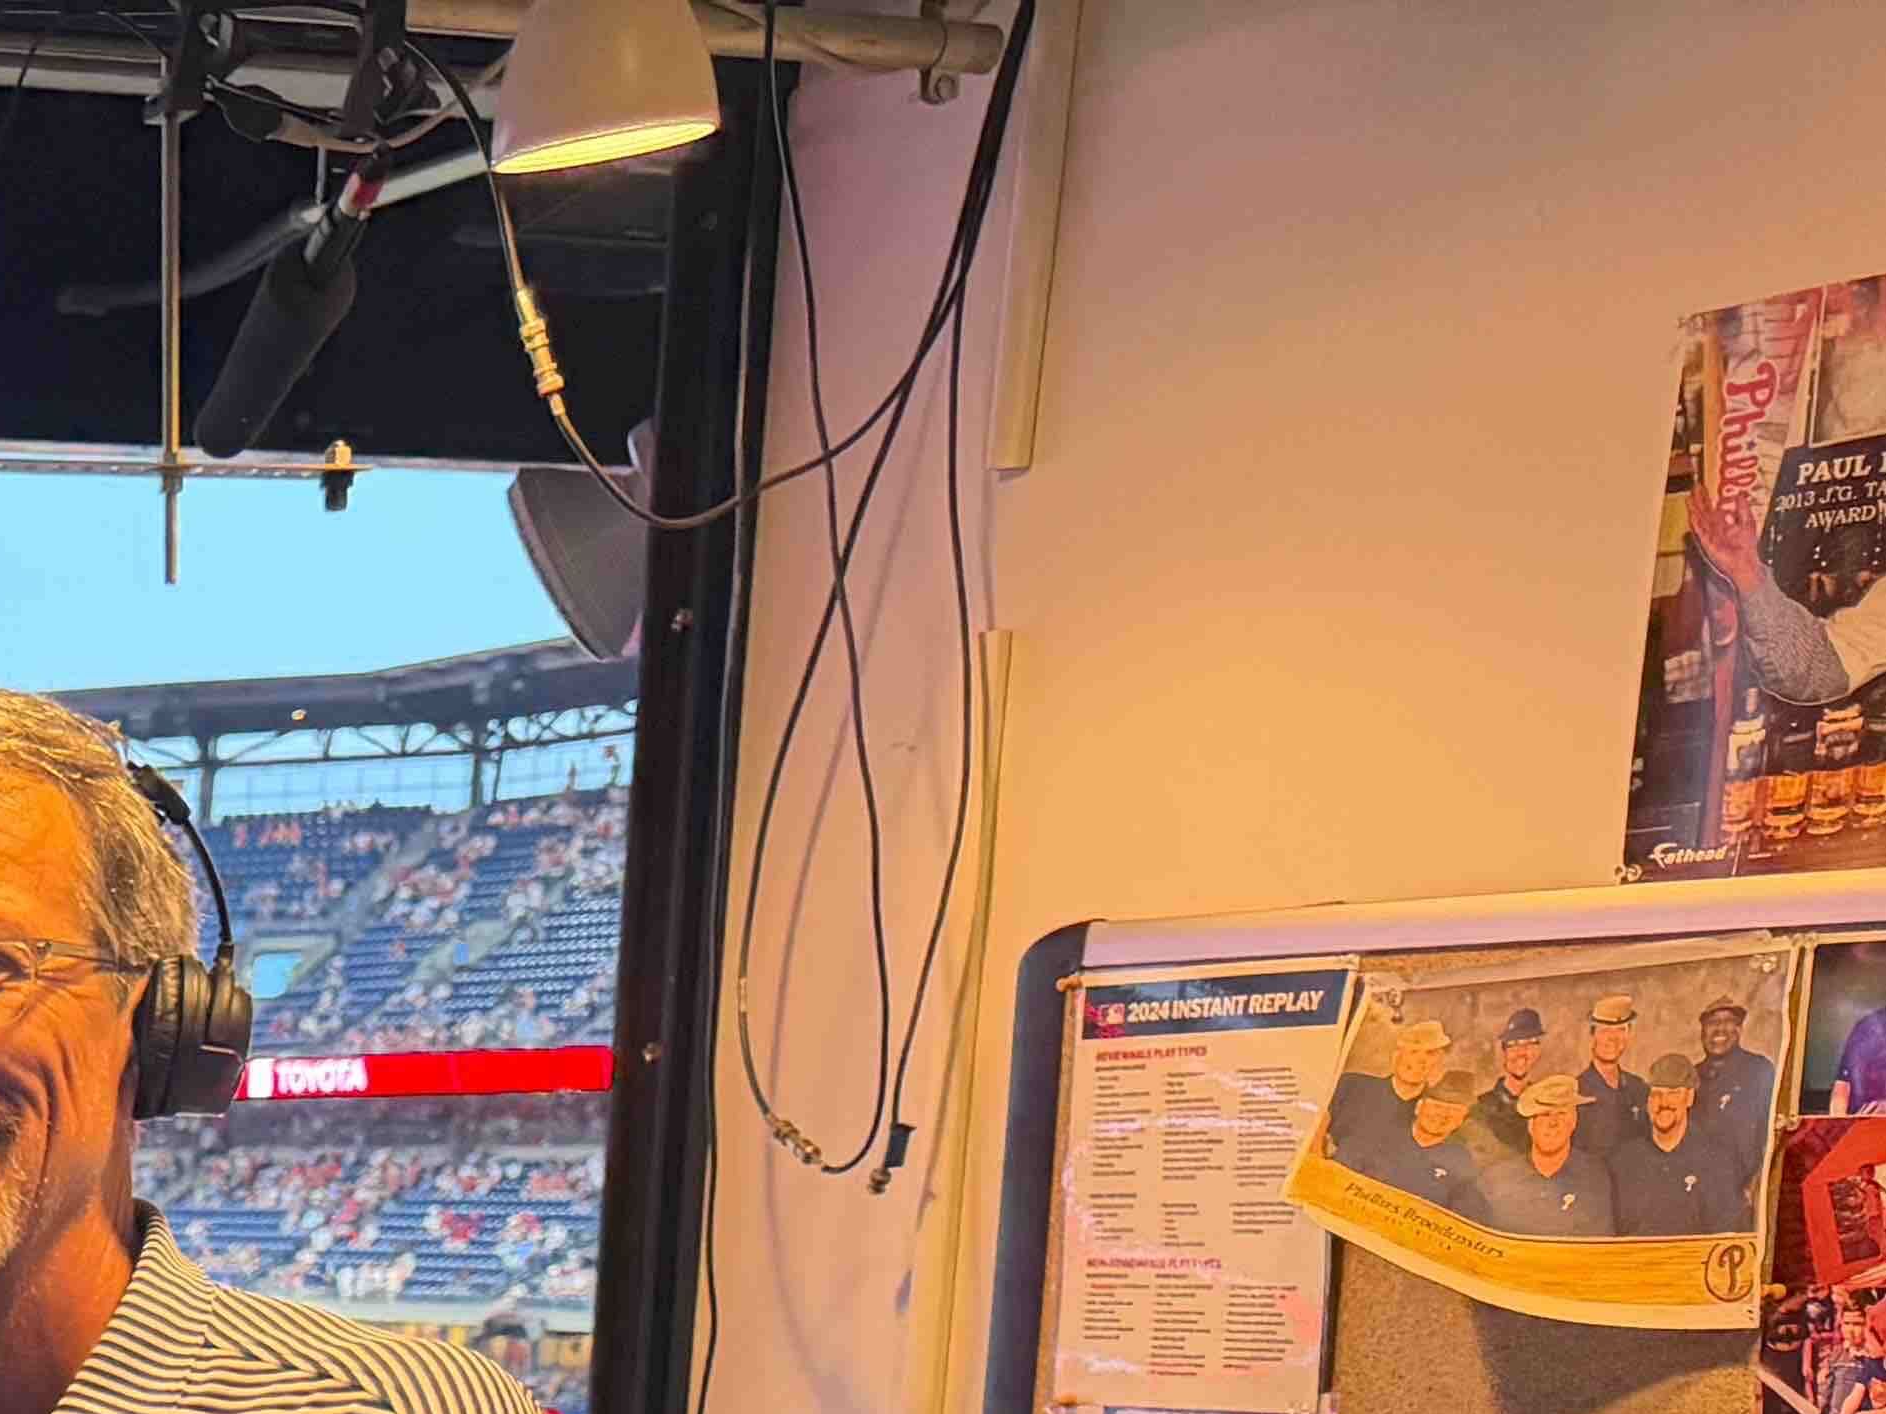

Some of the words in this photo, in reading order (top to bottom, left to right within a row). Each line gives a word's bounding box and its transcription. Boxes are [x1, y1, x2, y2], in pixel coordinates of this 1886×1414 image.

[1797, 454, 1872, 486] PAUL
[1775, 491, 1816, 512] 2013
[1804, 504, 1877, 530] AWARD
[1647, 842, 1729, 870] Fathead
[1127, 999, 1171, 1024] 2024
[1172, 993, 1248, 1021] INSTANT
[1249, 989, 1324, 1017] REPLAY
[274, 1058, 368, 1096] TOYOTA
